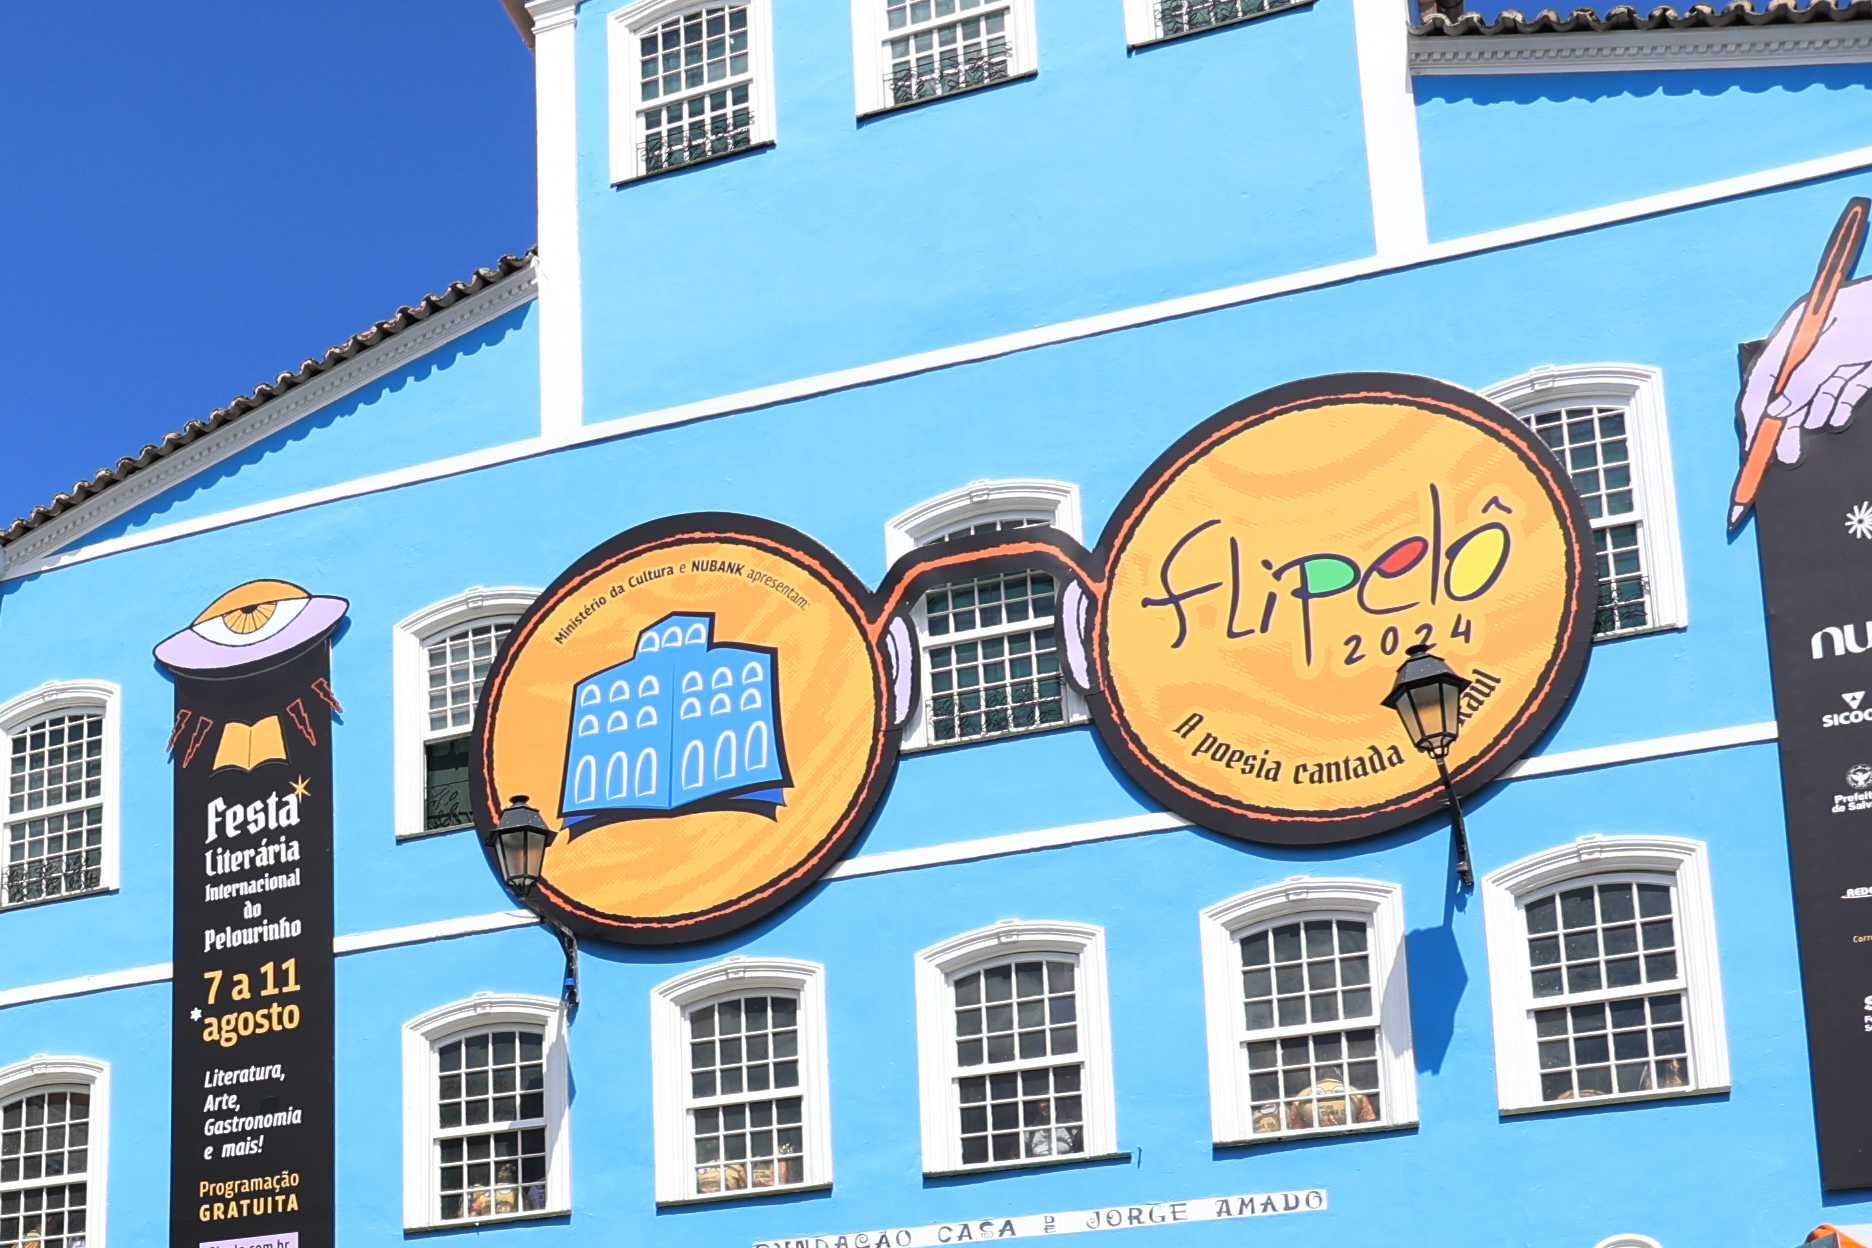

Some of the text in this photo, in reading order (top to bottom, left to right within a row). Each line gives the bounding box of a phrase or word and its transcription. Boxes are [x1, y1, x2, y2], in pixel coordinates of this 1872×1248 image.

[554, 594, 607, 646] Ministério
[609, 581, 626, 600] da
[628, 565, 675, 587] Cultura
[679, 562, 687, 574] e
[691, 560, 745, 577] NUBANK
[1343, 613, 1472, 666] 2024
[1173, 711, 1405, 785] A poesia cantada
[205, 790, 301, 844] Festa
[205, 837, 300, 877] Literária
[204, 868, 301, 902] Internacional
[243, 900, 262, 921] do
[204, 917, 302, 953] Pelourinho
[203, 957, 301, 1005] 7 a 11
[203, 1003, 301, 1048] agosto
[204, 1062, 286, 1088] Literatura,
[204, 1093, 241, 1113] Arte,
[204, 1107, 302, 1137] Gastronomia
[204, 1136, 264, 1160] e mais!
[199, 1170, 300, 1200] Programação
[199, 1193, 299, 1222] GRATUITA
[937, 1219, 1017, 1243] CASA
[1085, 1202, 1189, 1231] JORGE
[1215, 1190, 1326, 1219] AMADO
